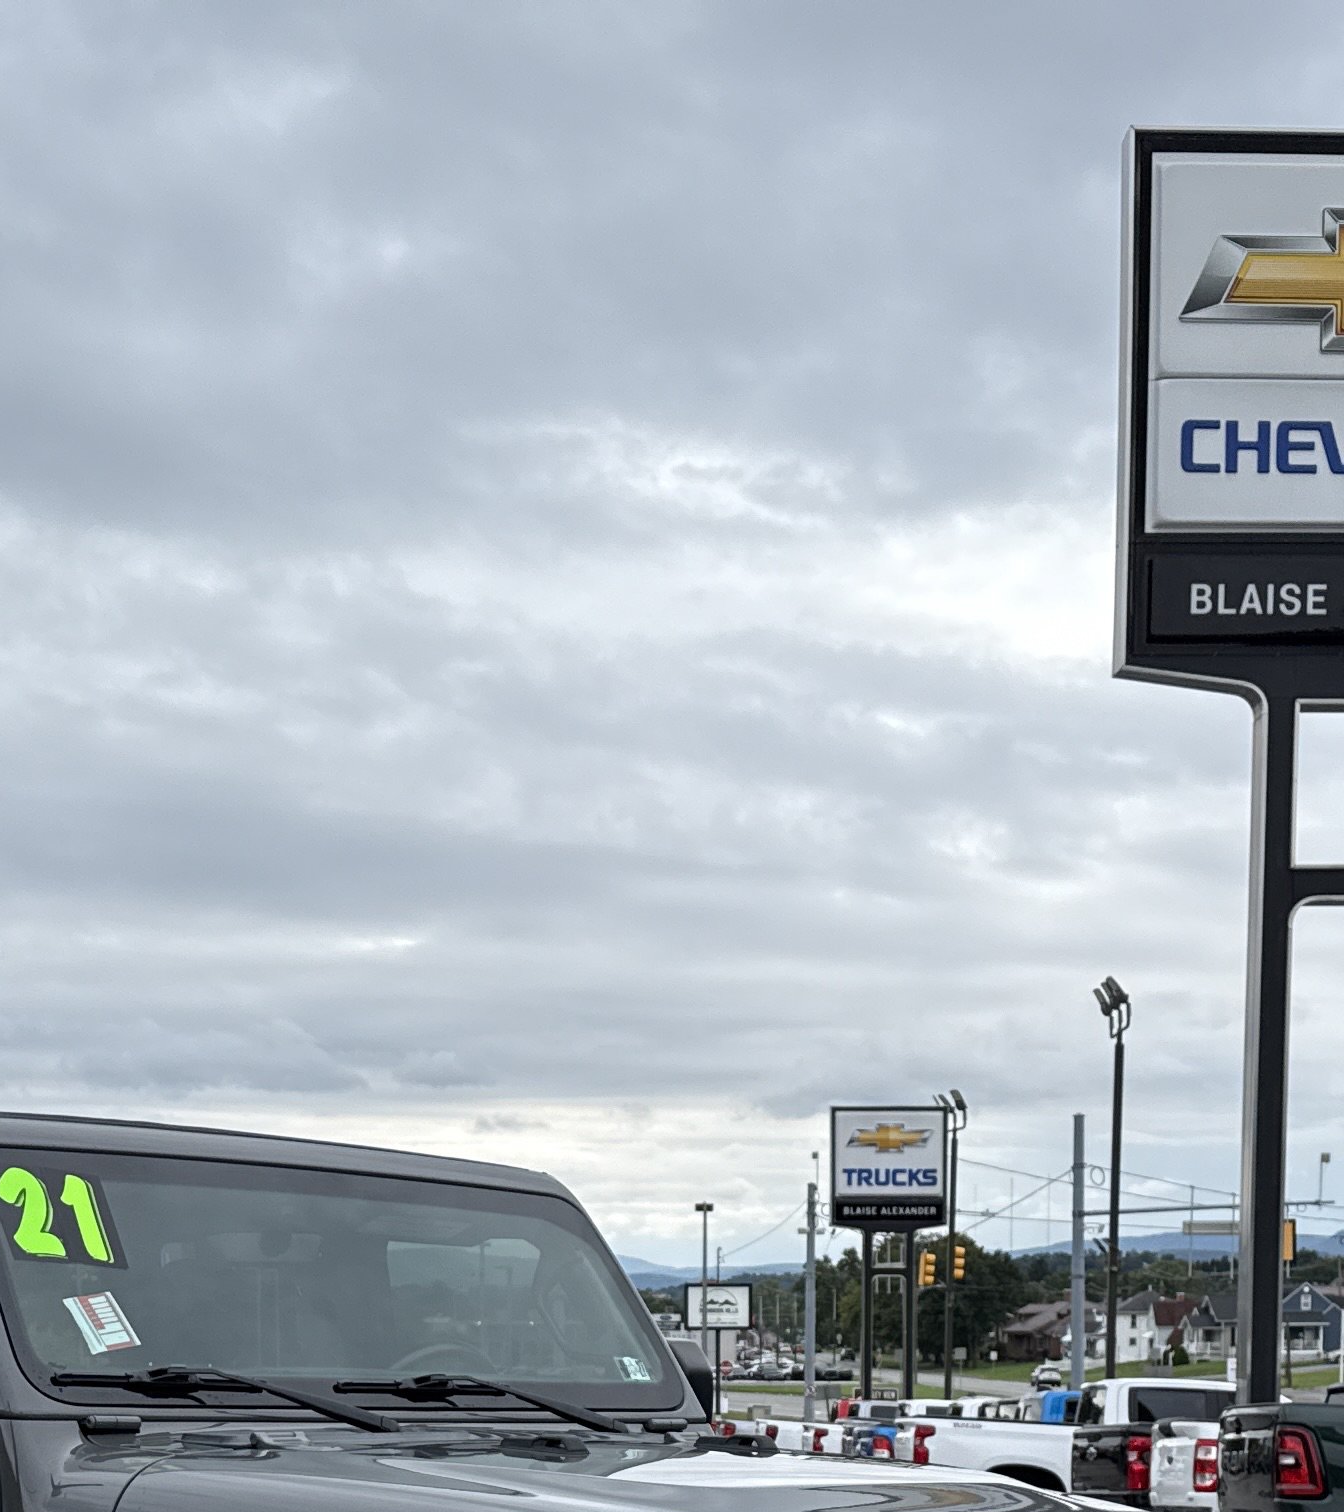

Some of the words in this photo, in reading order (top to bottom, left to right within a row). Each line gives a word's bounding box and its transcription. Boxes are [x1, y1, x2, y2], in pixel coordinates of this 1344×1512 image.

[1189, 582, 1327, 617] BLAISE
[842, 1168, 938, 1187] TRUCKS
[843, 1206, 878, 1216] BLAISE
[880, 1206, 937, 1216] ALEXANDER
